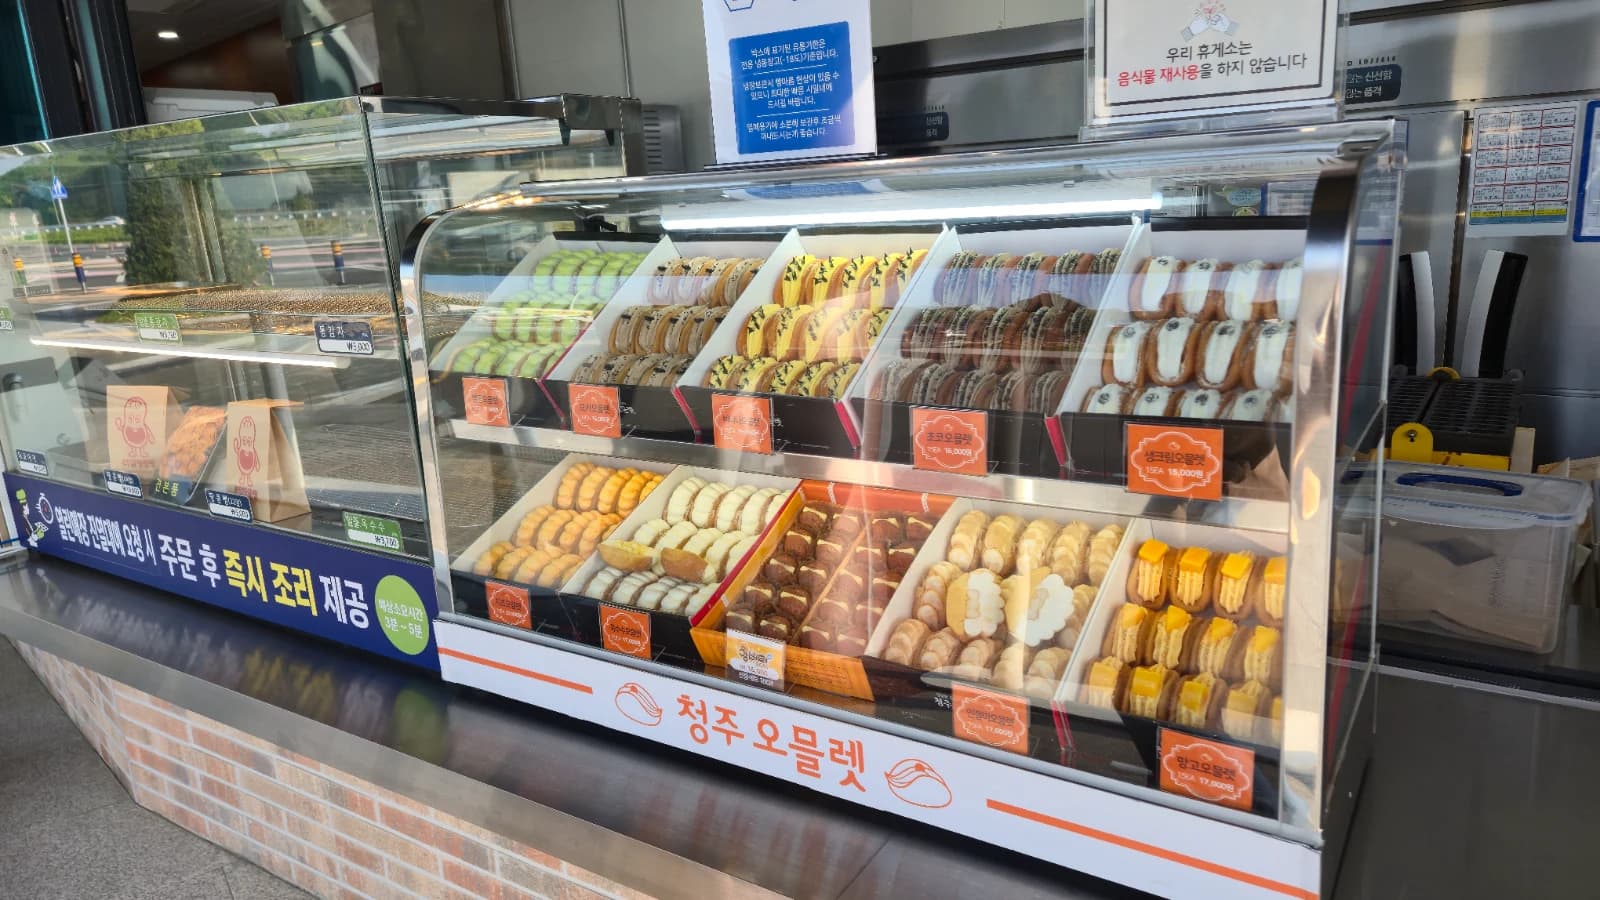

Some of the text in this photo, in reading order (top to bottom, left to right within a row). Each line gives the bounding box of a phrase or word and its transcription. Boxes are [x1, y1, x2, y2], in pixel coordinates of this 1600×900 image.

[751, 39, 826, 57] 박스에 표기된 유통기한은
[1165, 41, 1253, 64] 우리 휴게소는
[796, 73, 816, 84] 현상이
[832, 71, 841, 80] 수
[1117, 52, 1308, 87] 음식물 재사용을 하지 않습니다
[319, 324, 345, 338] 통감자
[926, 431, 973, 446] 초코오믈렛
[1144, 450, 1206, 466] 생크림오믈렛
[122, 523, 145, 563] 요청
[143, 528, 158, 566] 시
[158, 533, 198, 582] 주문
[199, 543, 221, 588] 후
[222, 549, 268, 603] 즉시
[270, 560, 318, 617] 조리
[318, 575, 369, 629] 제공
[378, 598, 423, 622] 예상소요시간
[385, 616, 399, 632] 3분
[408, 623, 423, 639] 5분
[965, 707, 1016, 728] 인절미오믈렛
[676, 693, 867, 793] 청주 오믈렛
[1176, 756, 1236, 781] 망고오믈렛
